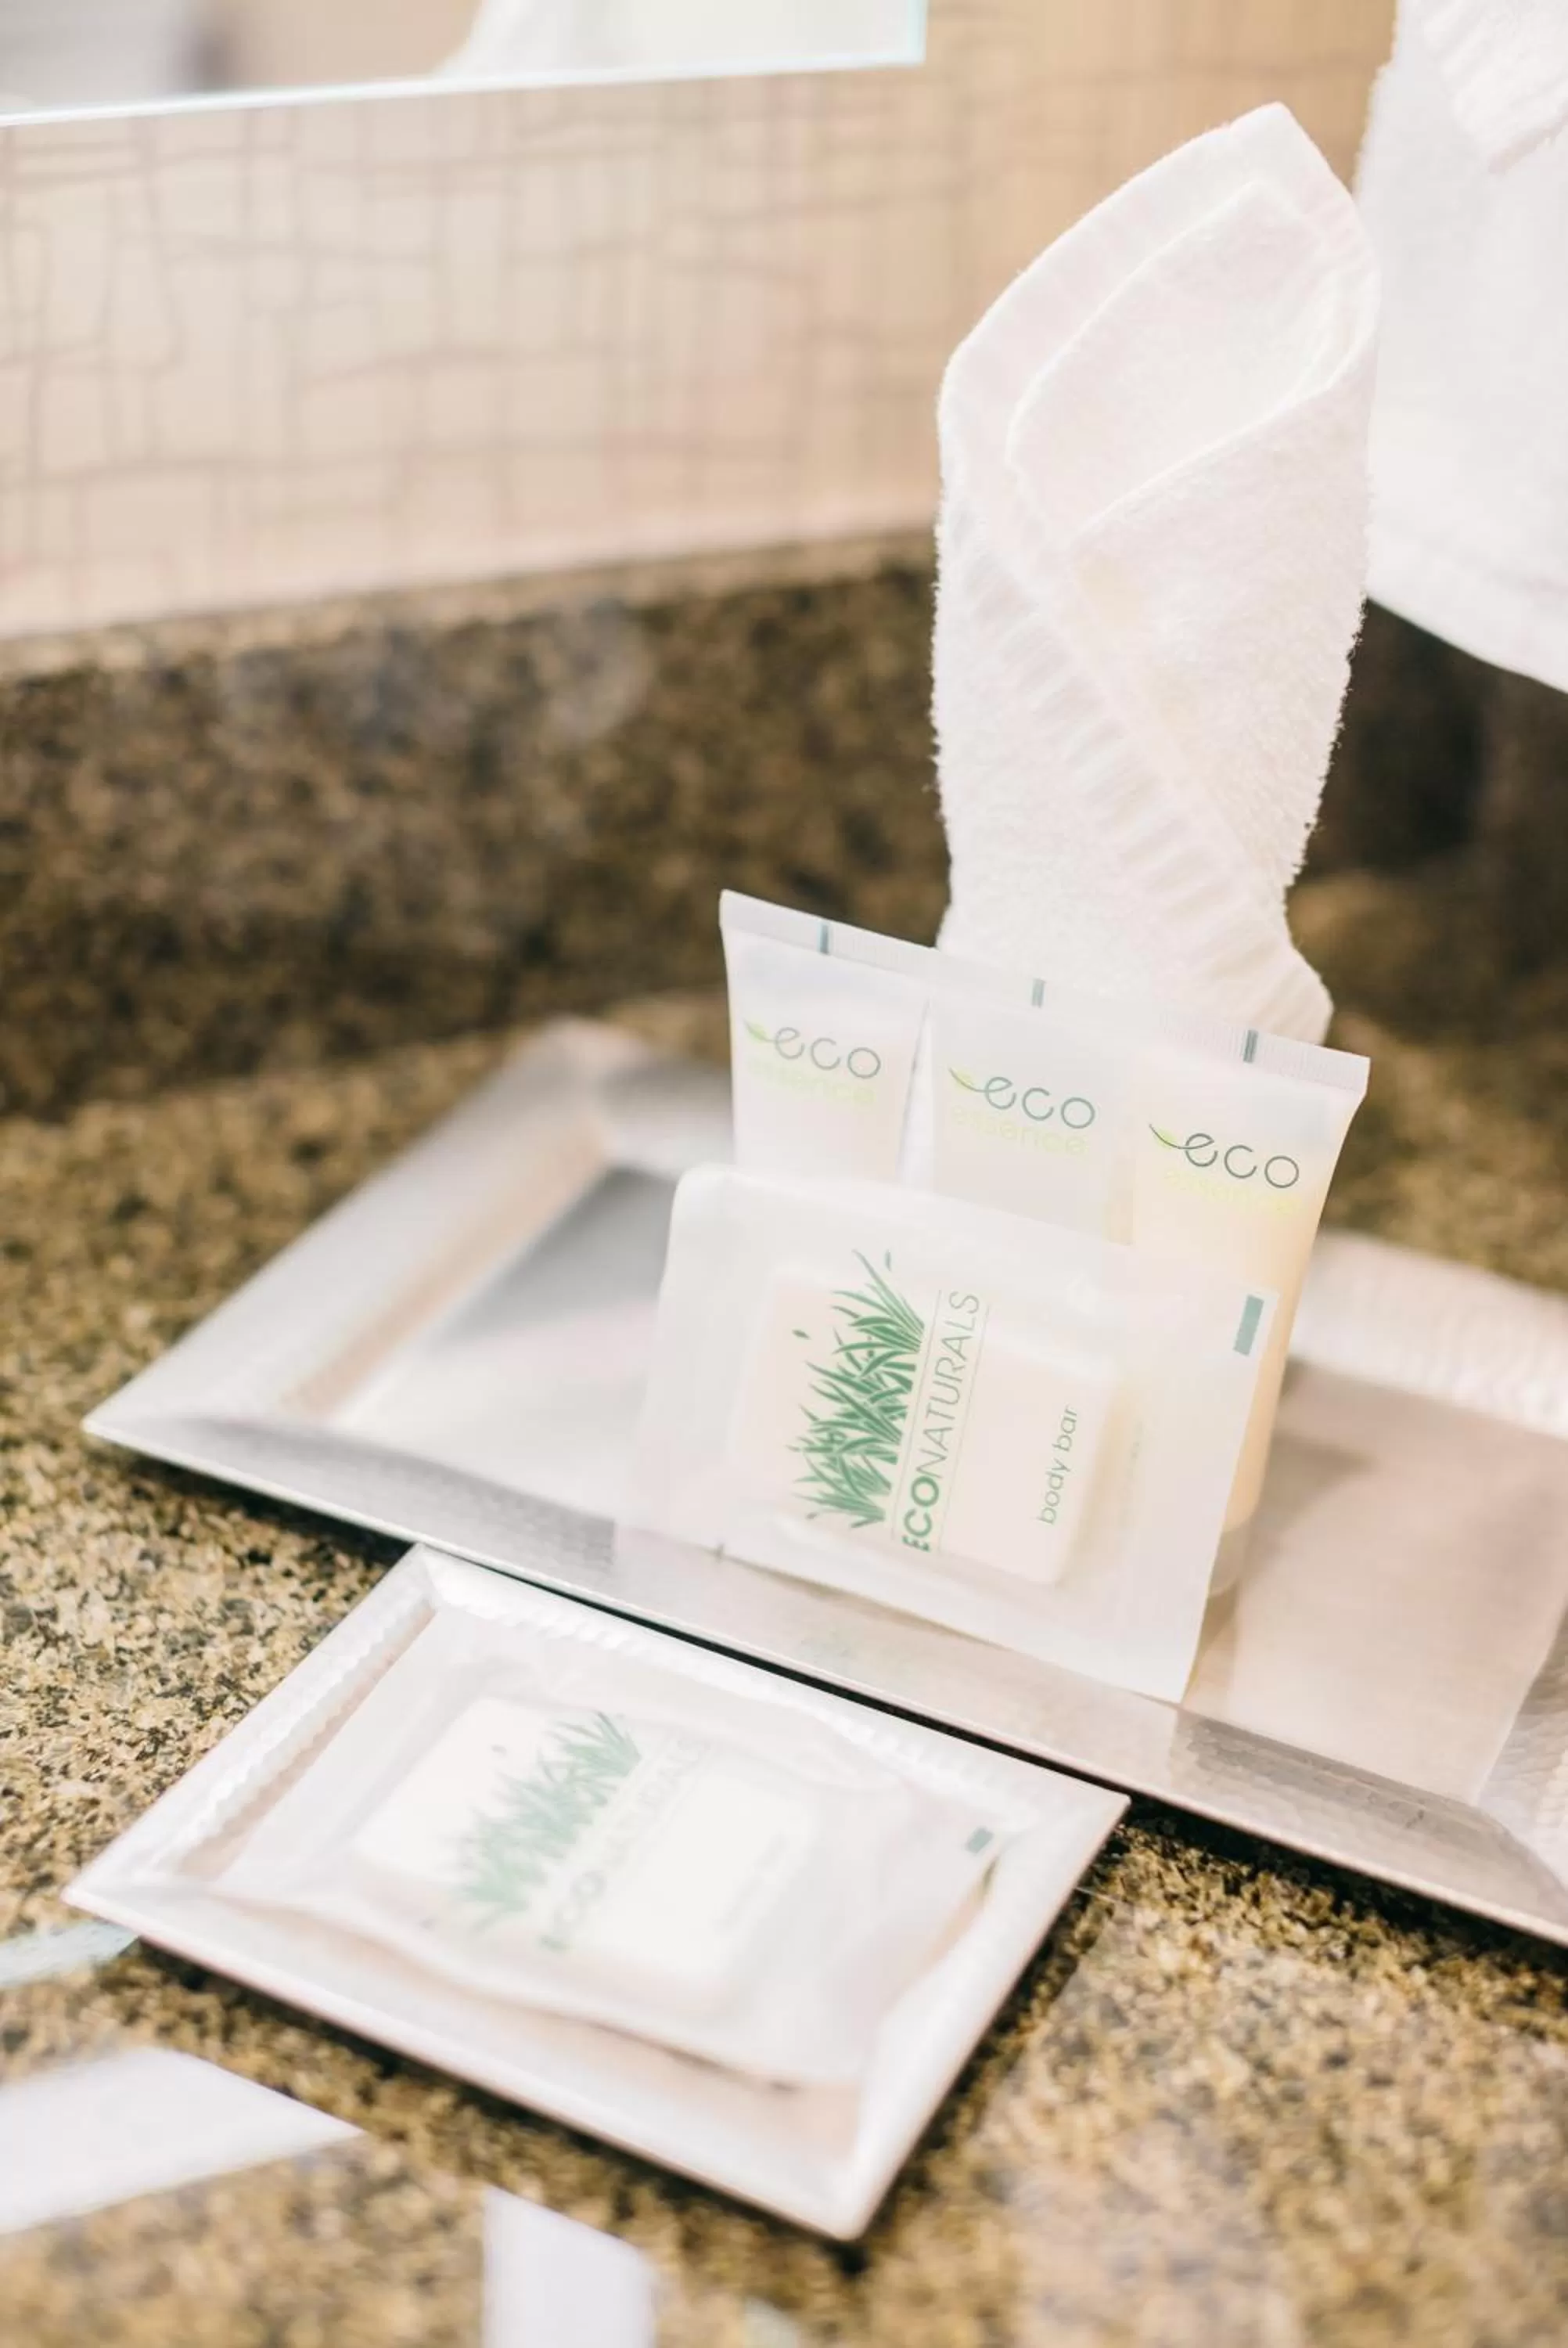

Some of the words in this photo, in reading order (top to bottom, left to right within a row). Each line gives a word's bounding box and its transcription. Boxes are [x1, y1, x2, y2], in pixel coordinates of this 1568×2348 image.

[775, 1026, 882, 1079] eco
[984, 1075, 1097, 1130] eco
[1185, 1133, 1300, 1189] eco
[901, 1289, 981, 1554] ECONATURALS
[1052, 1403, 1081, 1452] bar
[1036, 1457, 1074, 1525] body
